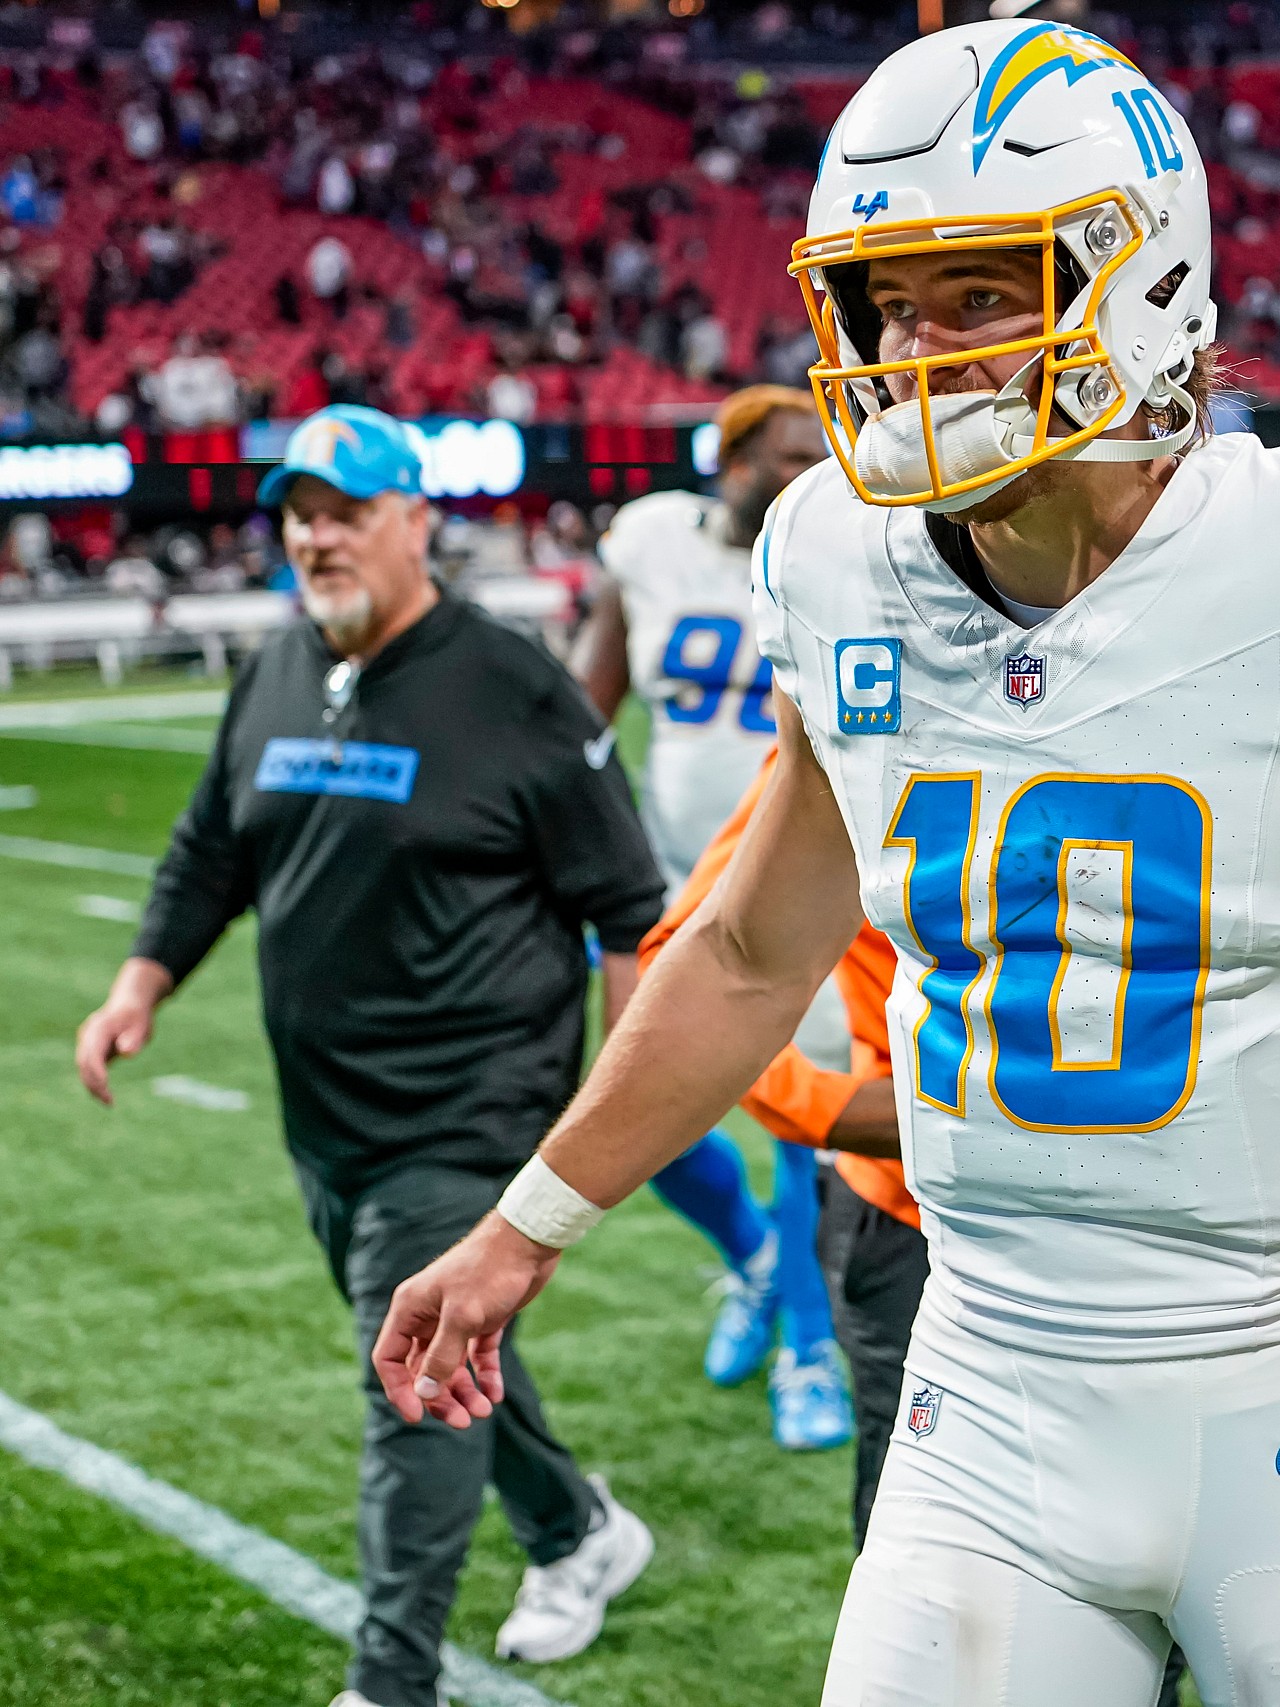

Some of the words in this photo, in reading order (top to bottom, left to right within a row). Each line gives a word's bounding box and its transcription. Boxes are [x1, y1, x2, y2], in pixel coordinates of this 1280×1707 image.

[1111, 88, 1184, 180] 10
[839, 644, 894, 708] C
[1009, 675, 1039, 700] NFL
[882, 770, 1213, 1134] 10
[910, 1408, 930, 1430] NFL
